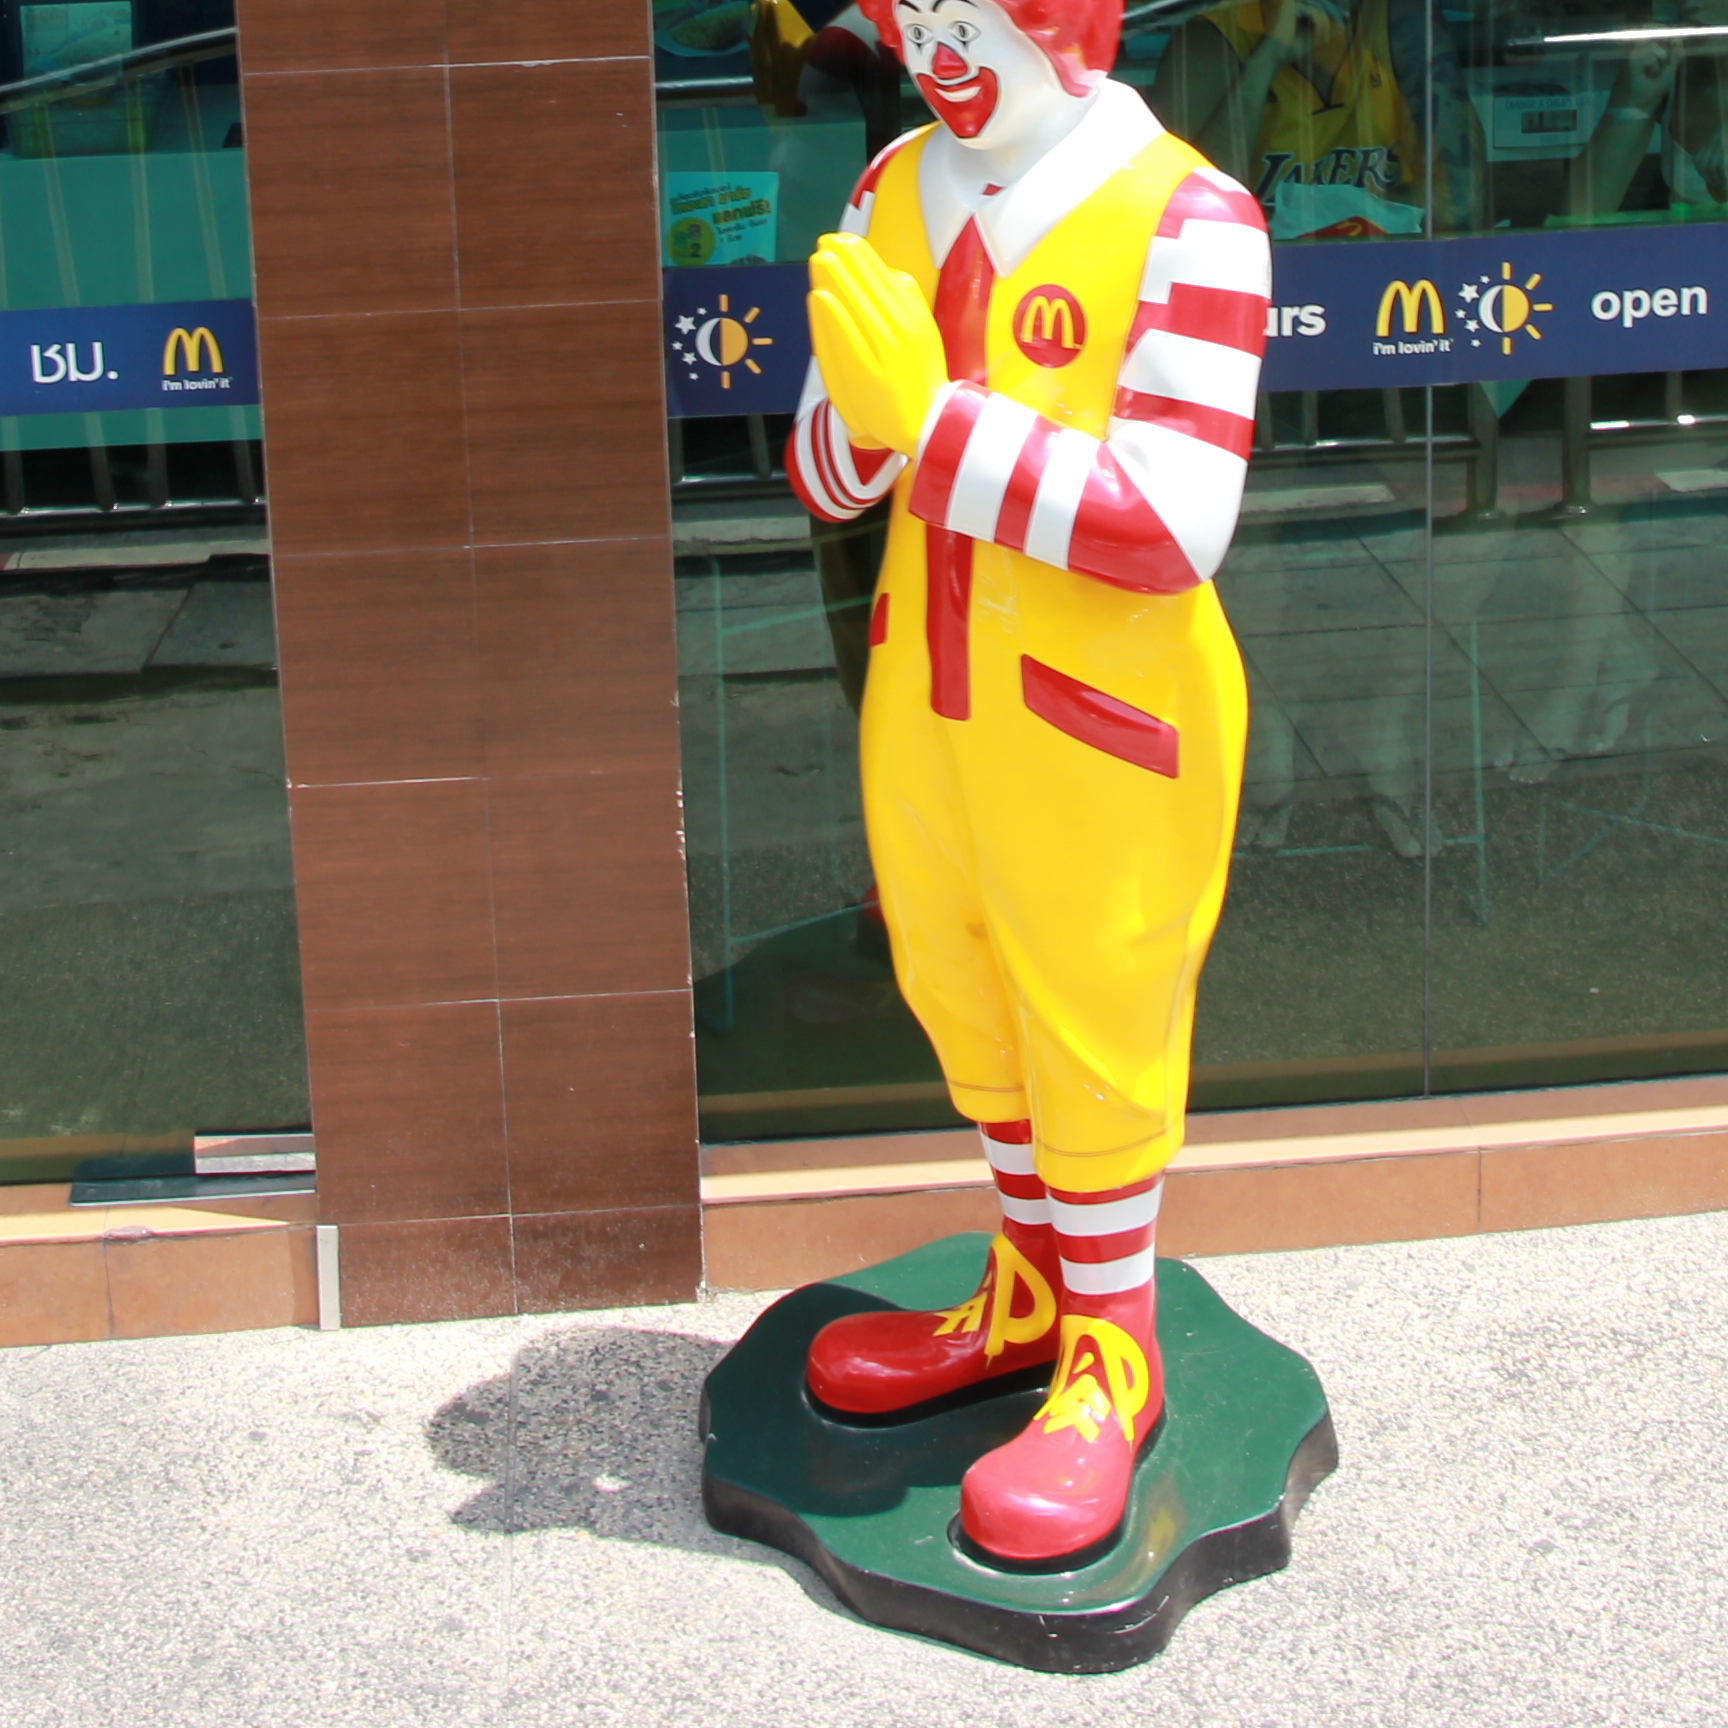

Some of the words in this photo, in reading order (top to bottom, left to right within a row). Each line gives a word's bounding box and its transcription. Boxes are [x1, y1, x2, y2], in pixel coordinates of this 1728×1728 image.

[1262, 303, 1326, 337] urs
[1591, 285, 1708, 328] open
[30, 341, 118, 384] ชม.
[1373, 342, 1396, 356] i'm
[1440, 338, 1451, 352] it
[162, 380, 181, 391] i'm
[219, 378, 230, 389] it
